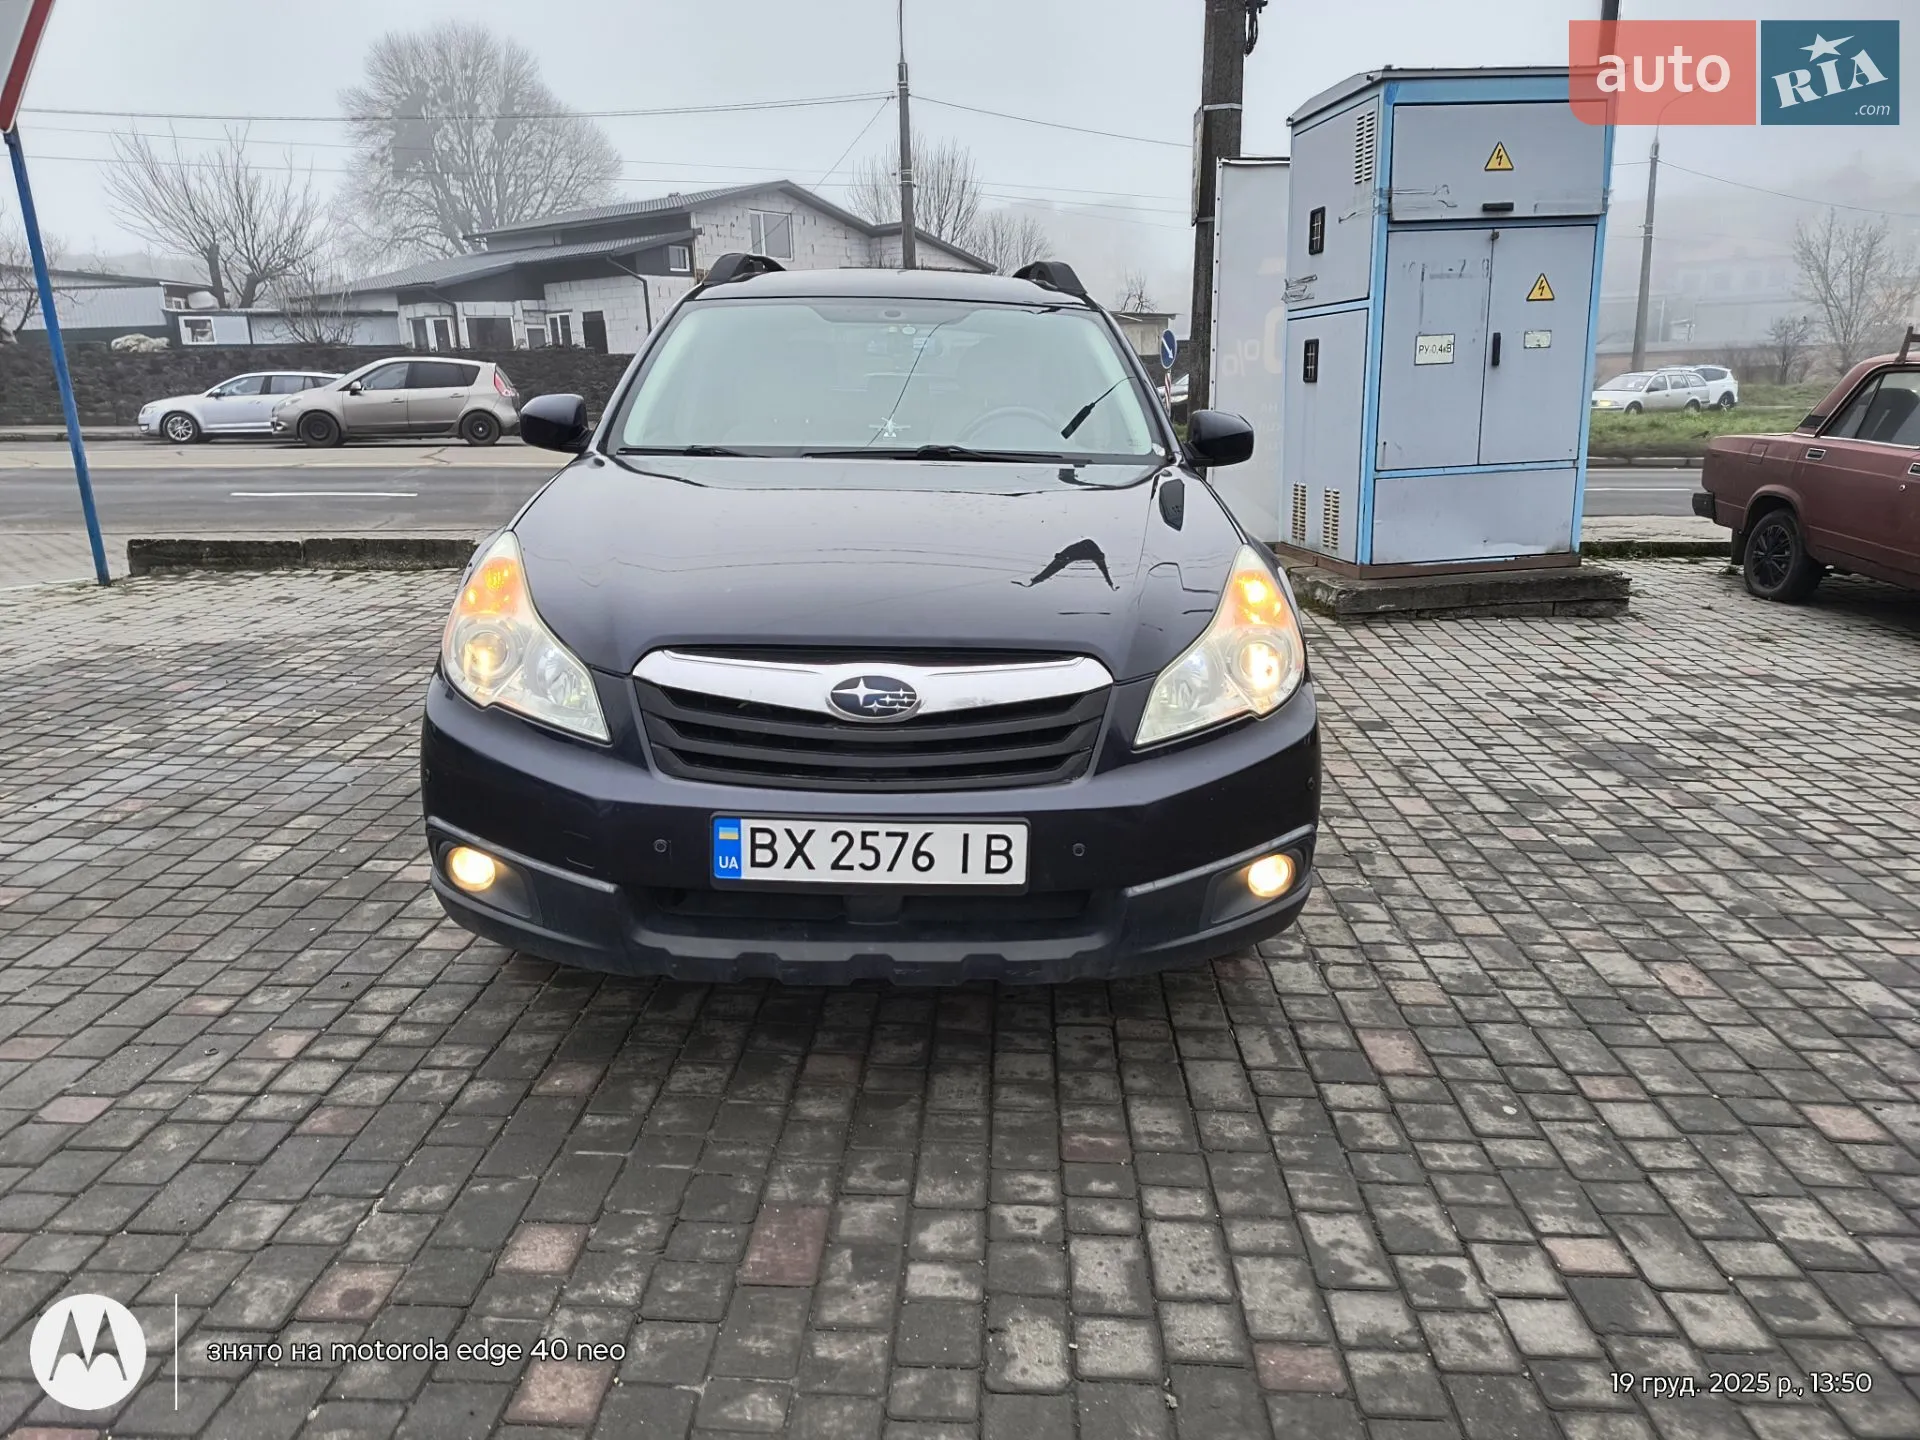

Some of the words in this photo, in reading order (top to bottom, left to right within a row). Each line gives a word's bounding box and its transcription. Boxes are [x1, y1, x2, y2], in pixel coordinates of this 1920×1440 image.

[718, 855, 739, 870] UA
[749, 826, 817, 871] BX
[830, 830, 936, 873] 2576
